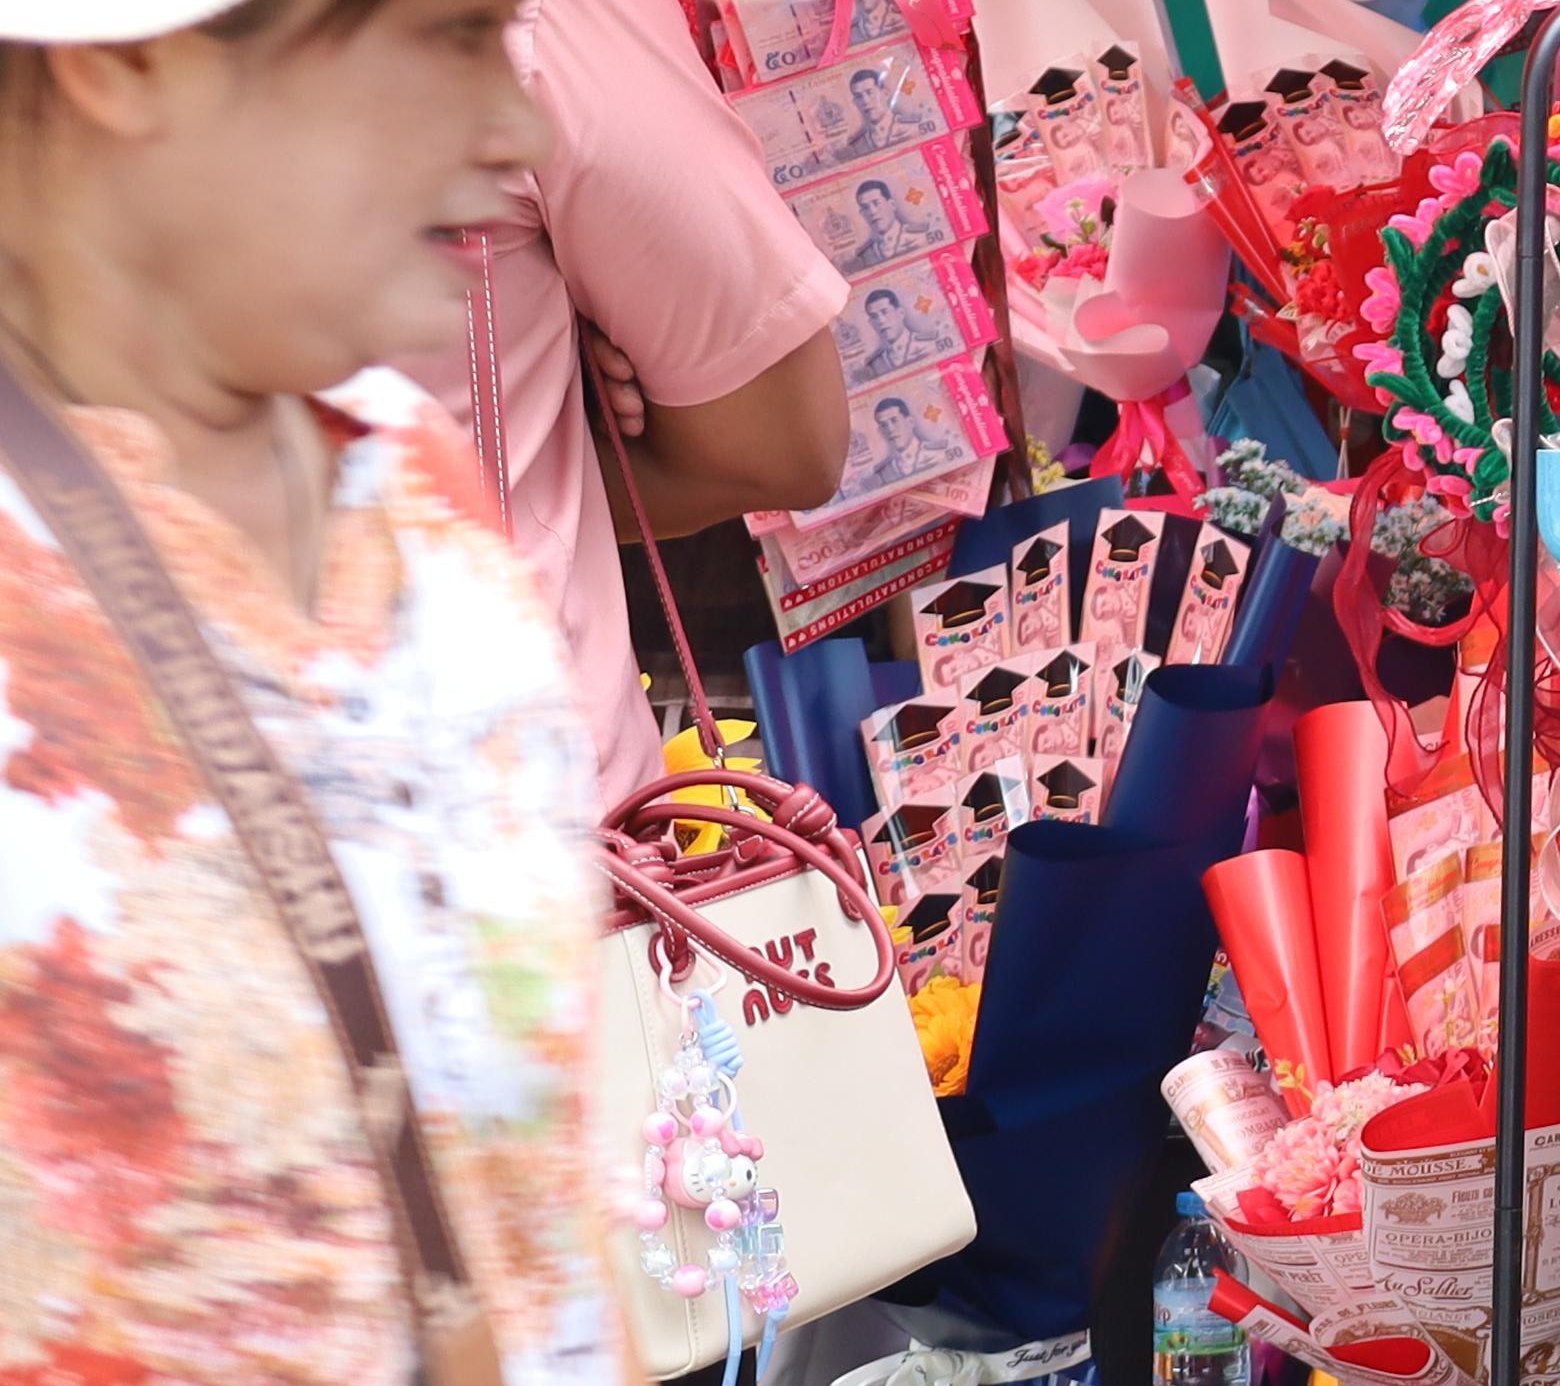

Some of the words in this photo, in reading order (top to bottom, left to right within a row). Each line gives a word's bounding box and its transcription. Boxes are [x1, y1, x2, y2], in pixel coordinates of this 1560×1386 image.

[918, 121, 936, 136] 50
[925, 229, 944, 245] 50
[936, 336, 954, 353] 50
[946, 446, 963, 461] 50
